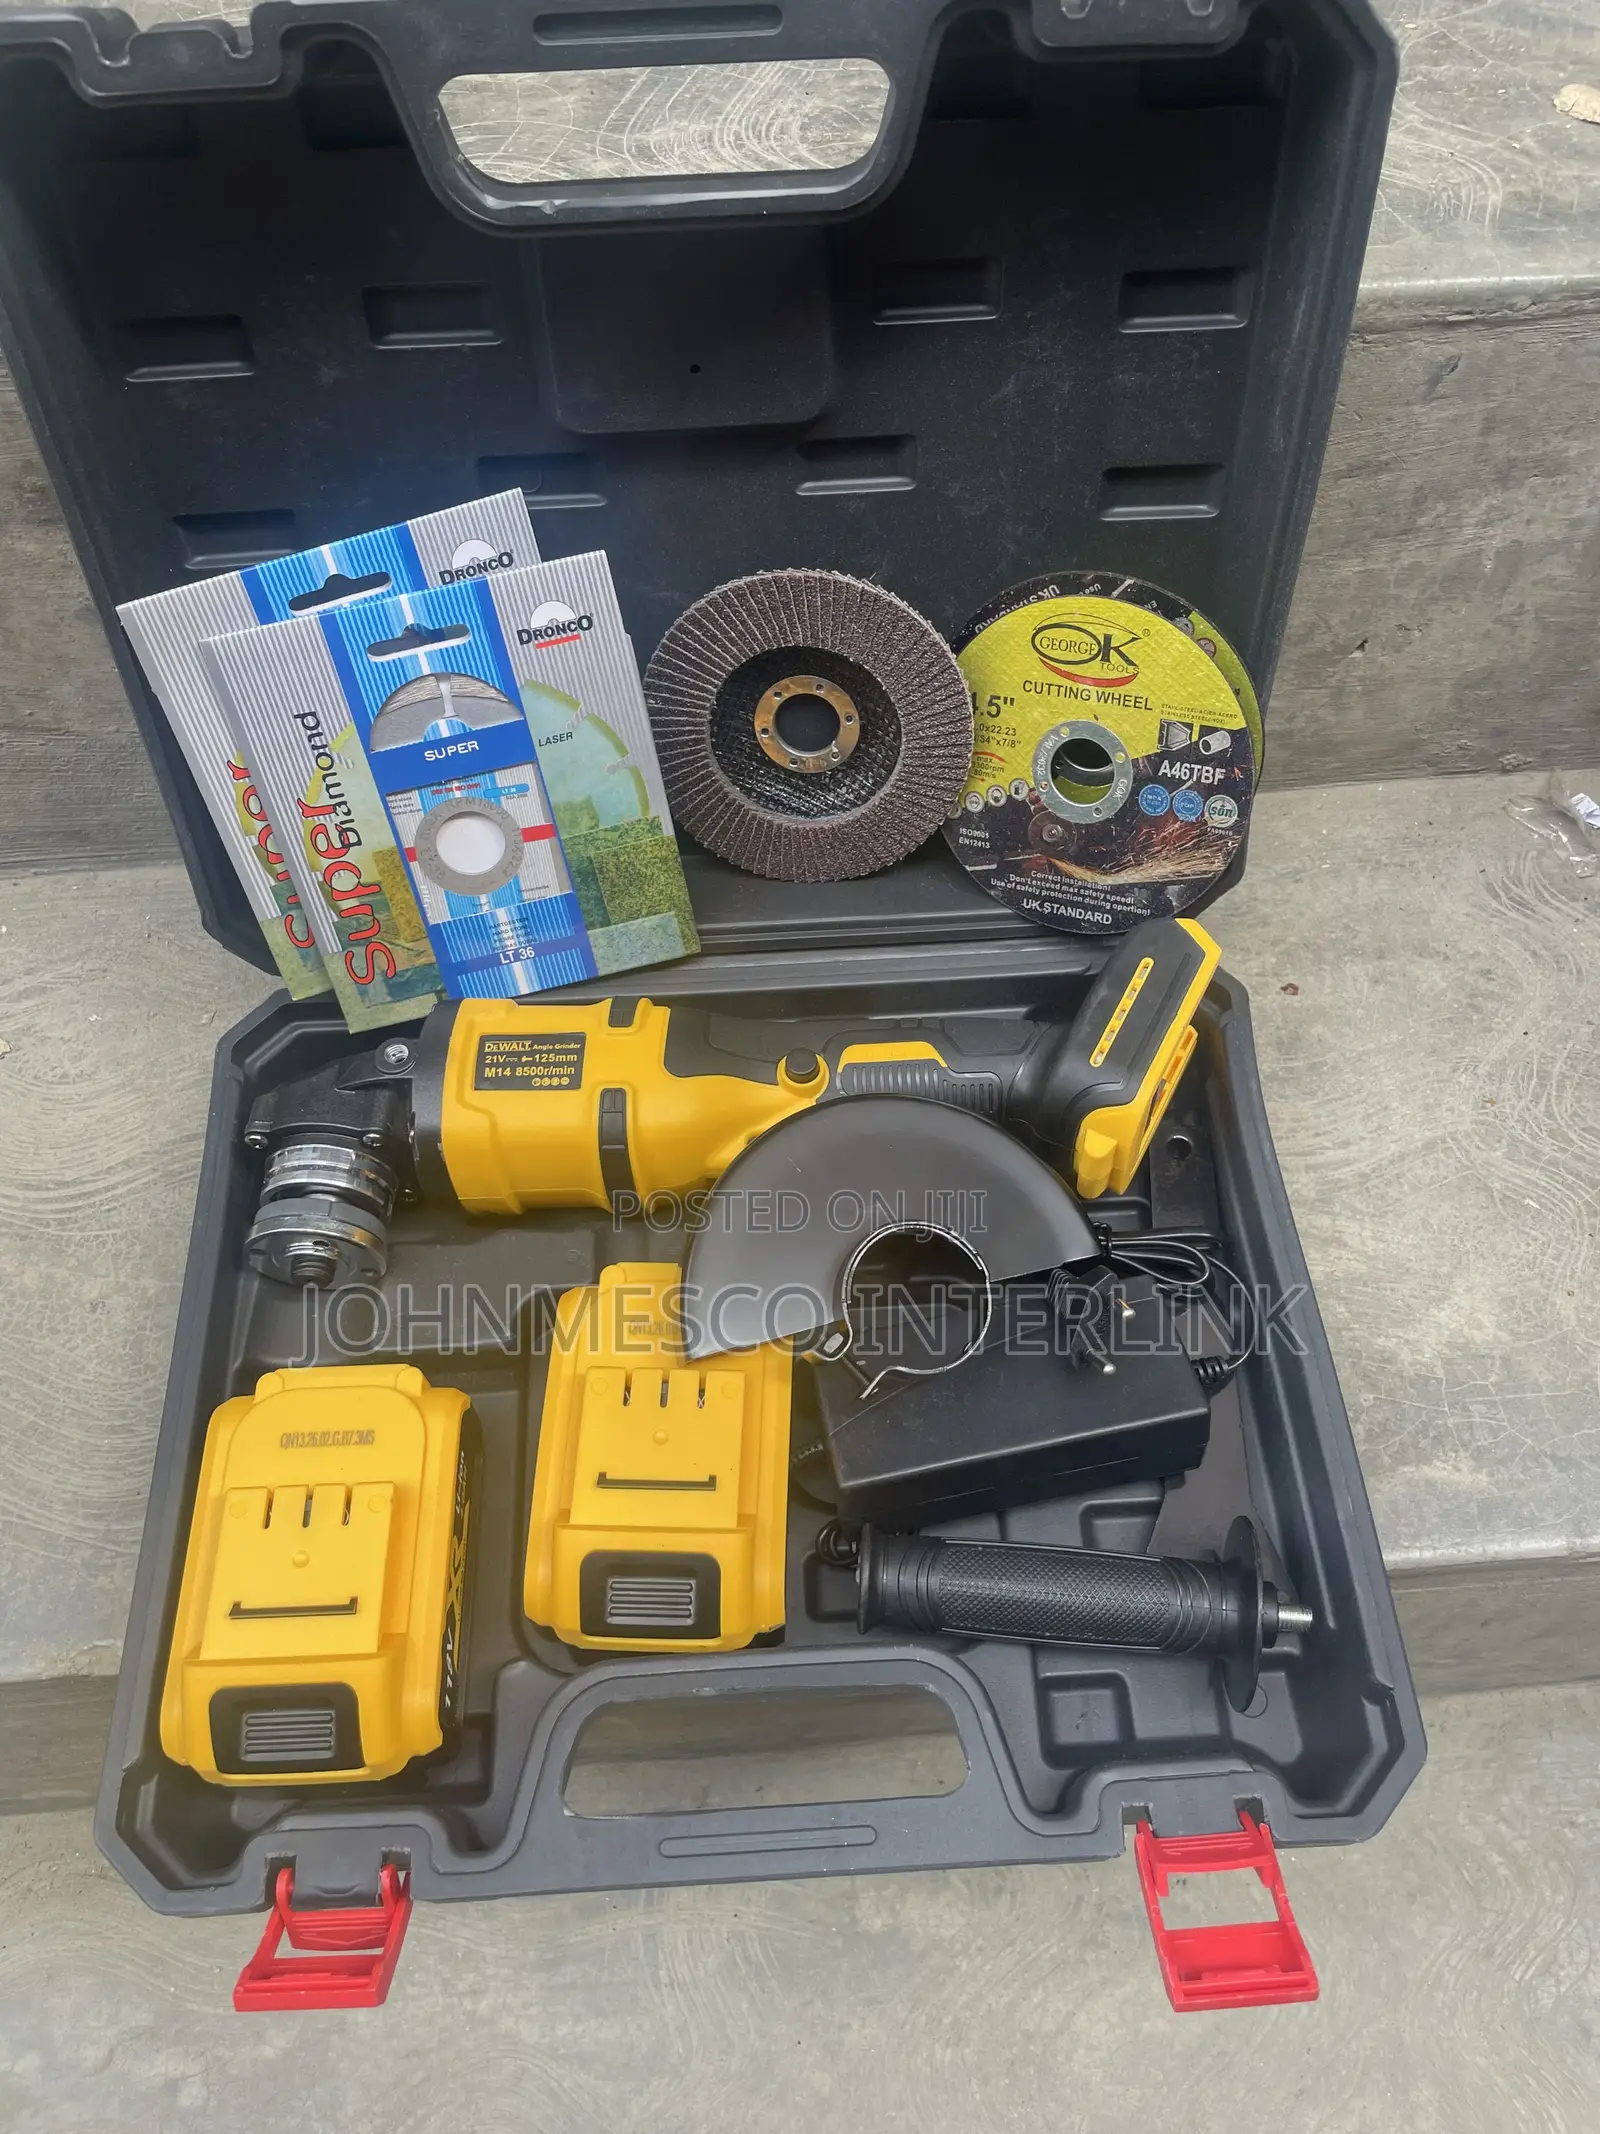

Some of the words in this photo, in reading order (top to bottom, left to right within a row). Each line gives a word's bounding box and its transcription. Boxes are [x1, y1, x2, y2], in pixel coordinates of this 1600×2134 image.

[439, 551, 514, 586] DRONCO
[517, 614, 594, 646] DRONCO
[1039, 636, 1097, 656] GEORGE
[1101, 662, 1140, 675] TOOLS
[1023, 679, 1092, 701] CUTTING
[1095, 690, 1153, 711] WHEEL
[538, 731, 574, 748] LASER
[975, 722, 1017, 737] .0x22.23
[424, 740, 480, 762] SUPER
[293, 710, 363, 850] Diamond
[1158, 759, 1226, 786] A46TBF
[958, 837, 991, 849] EN12413
[1031, 870, 1061, 883] Correct
[296, 797, 397, 986] Super
[990, 877, 1006, 887] Use
[1006, 881, 1016, 889] of
[1016, 883, 1041, 896] safety
[1041, 888, 1084, 903] protection
[1084, 895, 1111, 910] during
[1009, 873, 1031, 885] Don't
[1032, 879, 1061, 891] exceed
[1062, 885, 1079, 894] max
[1079, 886, 1105, 900] safety
[1106, 893, 1135, 905] speed!
[1022, 897, 1042, 911] UK
[1043, 901, 1113, 925] STANDARD
[500, 950, 515, 965] LT
[519, 946, 536, 961] 36
[532, 1043, 554, 1051] Angle
[554, 1042, 581, 1050] Grinder
[534, 1053, 578, 1063] 125mm
[484, 1066, 512, 1078] M14
[515, 1065, 575, 1077] 8500r/min
